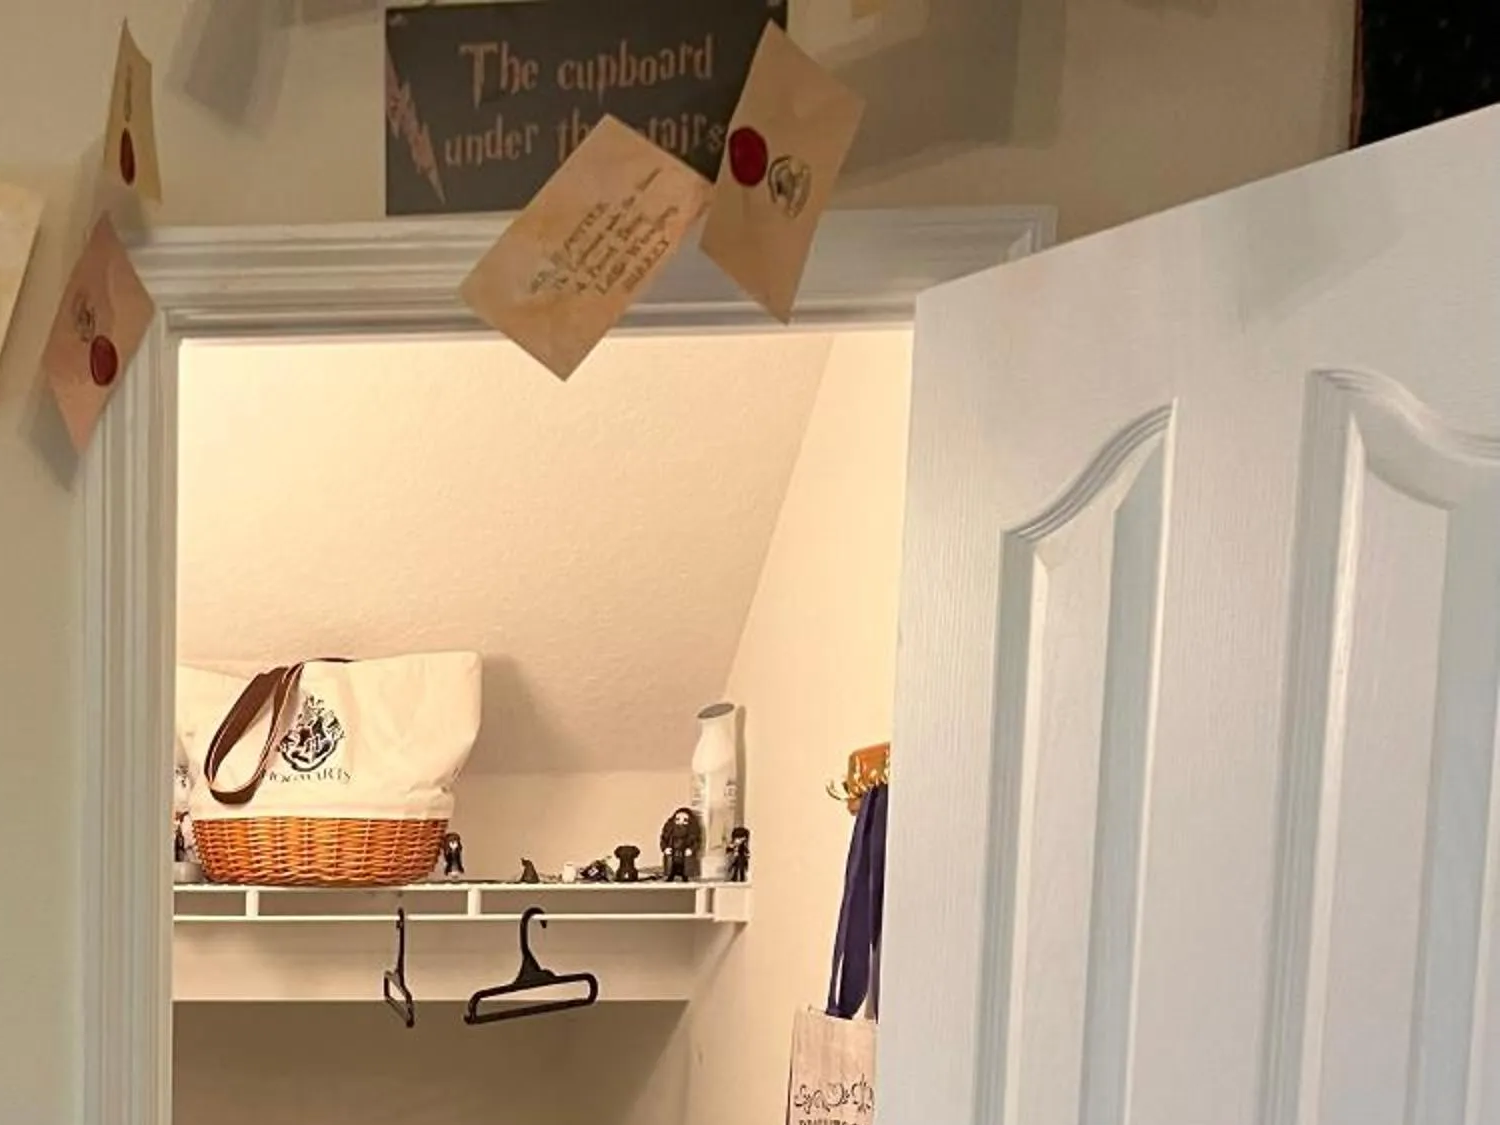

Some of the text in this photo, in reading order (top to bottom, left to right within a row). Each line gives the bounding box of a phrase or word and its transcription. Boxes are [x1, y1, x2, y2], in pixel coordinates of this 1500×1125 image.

[458, 32, 715, 109] The cupboard
[445, 107, 726, 166] under th tairs
